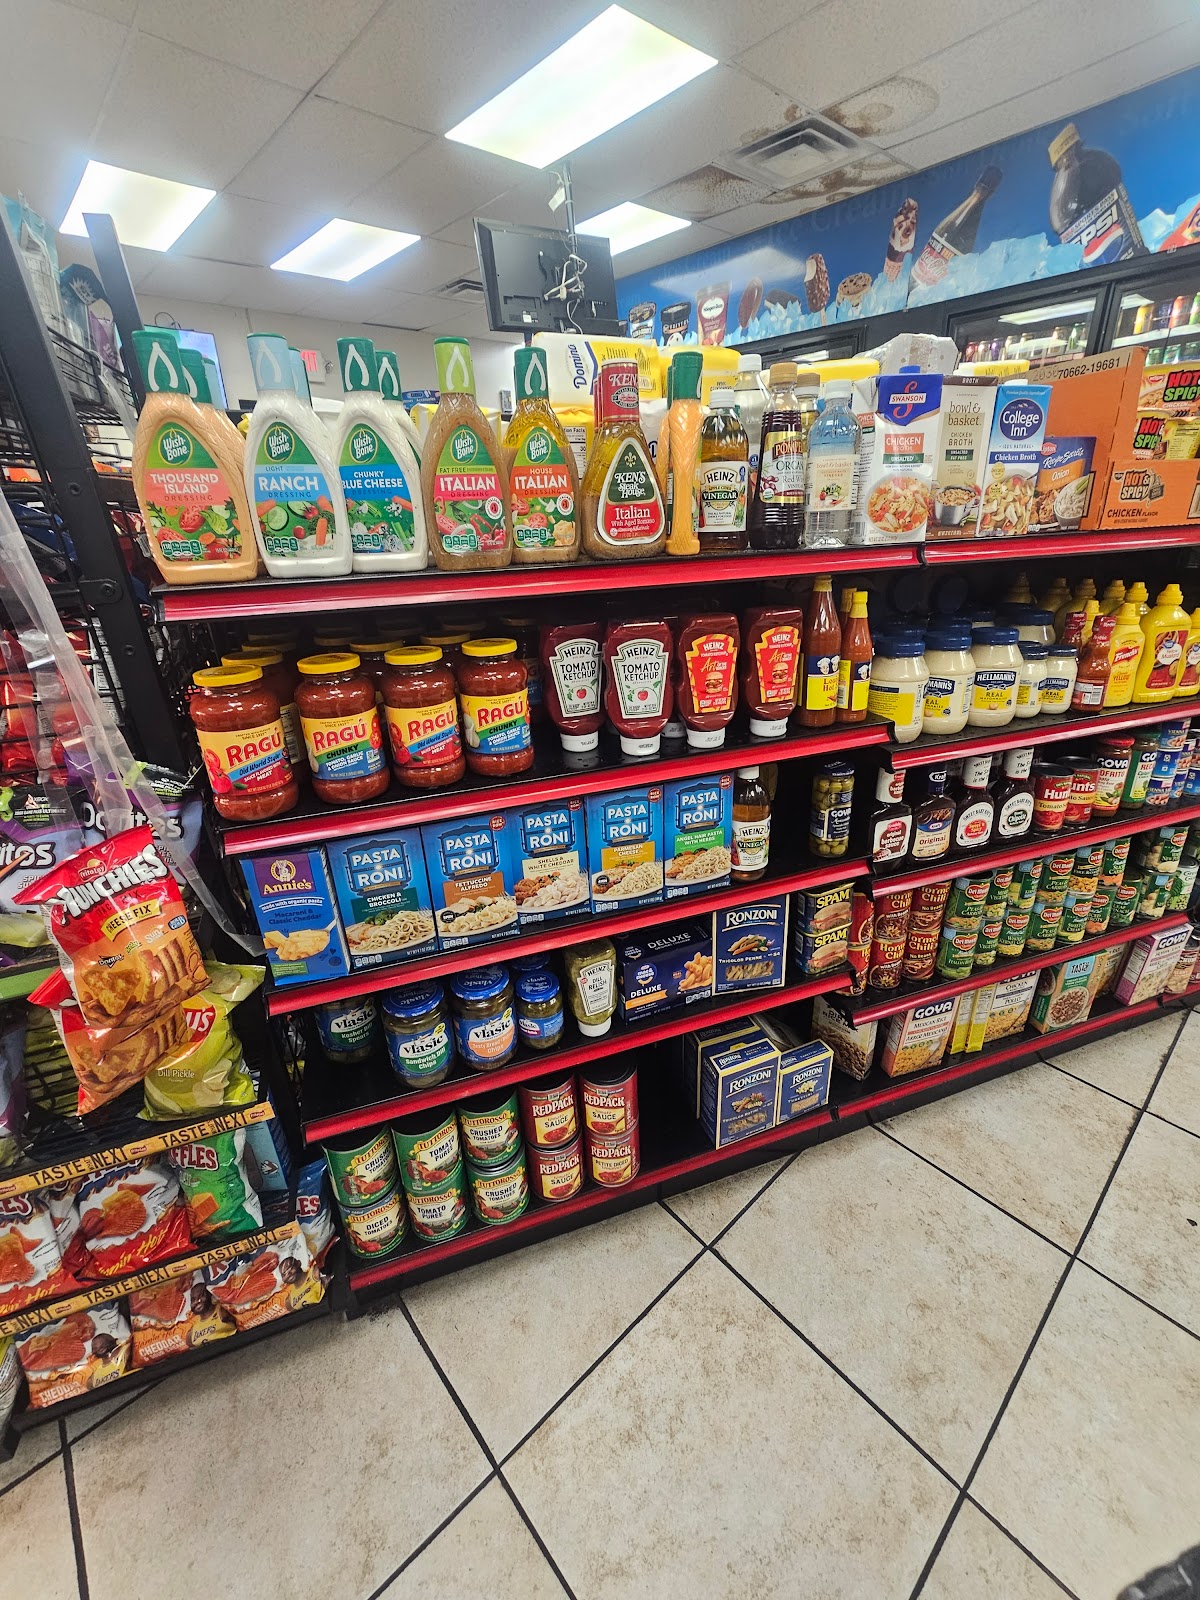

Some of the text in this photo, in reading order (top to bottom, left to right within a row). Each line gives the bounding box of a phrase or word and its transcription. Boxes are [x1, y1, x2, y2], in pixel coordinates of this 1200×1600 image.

[568, 344, 588, 389] Domino
[1058, 357, 1121, 380] 70662-19681
[892, 394, 925, 403] SWANSON
[950, 401, 972, 414] bowl
[948, 413, 979, 426] basket
[1002, 410, 1040, 427] College
[268, 432, 289, 445] Wish-
[1010, 426, 1027, 437] Inn
[163, 434, 186, 450] Wish-
[354, 433, 373, 447] Wish-
[455, 435, 474, 449] Wish-
[529, 436, 547, 450] Wish-
[886, 436, 921, 446] CHICKEN
[948, 438, 974, 446] BROTH
[167, 446, 189, 461] Bone
[271, 443, 291, 458] Bone
[356, 445, 375, 459] Bone
[457, 445, 475, 459] Bone
[531, 446, 548, 460] Bone
[150, 473, 219, 484] THOUSAND
[353, 470, 384, 478] CHUNKY
[614, 471, 646, 483] KEN'S
[706, 471, 735, 483] HEINZ
[1051, 470, 1070, 482] Onion
[164, 483, 209, 494] ISLAND
[258, 475, 319, 491] RANCH
[341, 478, 404, 490] BLUE CHEESE
[440, 476, 496, 491] ITALIAN
[514, 474, 568, 490] ITALIAN
[702, 490, 739, 500] VINEGAR
[1120, 485, 1150, 501] SPICY
[615, 505, 650, 520] Italian
[1107, 508, 1142, 518] CHICKEN
[624, 518, 637, 527] Aged
[771, 633, 791, 643] HEINZ
[564, 646, 591, 658] HEINZ
[625, 647, 656, 658] HEINZ
[703, 641, 724, 651] HEINZ
[560, 660, 597, 674] TOMATO
[621, 661, 661, 674] TOMATO
[563, 670, 596, 681] KETCHUP
[624, 671, 659, 682] KETCHUP
[977, 672, 1017, 683] HELLMANN'S
[477, 696, 525, 728] RAGÚ
[407, 705, 455, 741] RAGÚ
[488, 719, 517, 734] CHUNKY
[312, 718, 367, 753] RAGÚ
[225, 726, 281, 767] RAGÚ
[326, 744, 359, 760] CHUNKY
[249, 758, 267, 773] World
[256, 770, 273, 782] MEAT
[682, 791, 719, 806] PASTA
[607, 804, 647, 819] PASTA
[683, 808, 718, 825] RONI
[526, 813, 568, 829] PASTA
[610, 821, 647, 838] RONI
[742, 827, 765, 837] HEINZ
[446, 833, 491, 850] PASTA
[530, 831, 569, 849] RONI
[676, 835, 693, 843] ANGEL
[919, 834, 946, 845] Original
[352, 848, 401, 866] PASTA
[618, 849, 640, 857] CHEESE
[450, 851, 493, 871] RONI
[528, 858, 575, 871] WHITE CHEDDAR
[357, 867, 404, 887] RONI
[455, 876, 493, 888] FETTUCCINE
[263, 879, 313, 895] Annie's
[460, 882, 488, 892] ALFREDO
[367, 893, 396, 903] CHICKEN
[369, 897, 402, 908] BROCCOLI
[817, 889, 851, 909] SPAM
[106, 905, 152, 933] CHEESE FIX
[268, 913, 322, 925] Classic Cheddar
[274, 909, 307, 918] Macaroni
[726, 909, 777, 927] RONZONI
[647, 932, 692, 949] DELUXE
[814, 928, 849, 948] SPAM
[1159, 932, 1187, 949] GOYA
[587, 965, 607, 977] HEINZ
[588, 979, 608, 990] RELISH
[592, 976, 603, 985] DILL
[1005, 980, 1028, 991] CHICKEN
[630, 984, 662, 999] DELUXE
[1004, 996, 1022, 1005] POLLO
[914, 1001, 953, 1019] GOYA
[341, 1029, 364, 1039] Kosher
[348, 1031, 370, 1043] Spears
[405, 1052, 437, 1065] Sandwich
[418, 1059, 437, 1070] Chips
[158, 1069, 195, 1079] Dill Pickle
[792, 1066, 823, 1085] RONZONI
[729, 1070, 771, 1093] RONZONI
[532, 1094, 574, 1117] REDPACK
[584, 1091, 625, 1107] REDPACK
[463, 1113, 508, 1126] TUTTOROSSO
[544, 1115, 569, 1128] SAUCE
[592, 1111, 617, 1120] SAUCE
[159, 1111, 249, 1148] TASTE NEXT
[469, 1125, 503, 1136] CRUSHED
[473, 1132, 501, 1142] TOMATOES
[429, 1135, 456, 1158] TOMATO
[591, 1145, 631, 1158] REDPACK
[29, 1160, 86, 1187] TASTE
[92, 1147, 130, 1169] NEXT
[540, 1153, 580, 1174] REDPACK
[550, 1173, 574, 1185] SAUCE
[485, 1182, 517, 1197] CRUSHED
[488, 1189, 516, 1201] TOMATOES
[417, 1205, 447, 1217] TOMATO
[422, 1211, 444, 1219] PUREE
[364, 1220, 393, 1236] TOMATOES
[366, 1216, 389, 1230] DICED
[138, 1228, 167, 1257] Hot
[198, 1229, 278, 1265] TASTE NEXT
[83, 1266, 171, 1306] TASTE NEXT
[16, 1307, 51, 1331] NEXT
[193, 1325, 216, 1342] LAKERS
[139, 1335, 183, 1357] CHEDDAR
[95, 1368, 120, 1386] LAKERS
